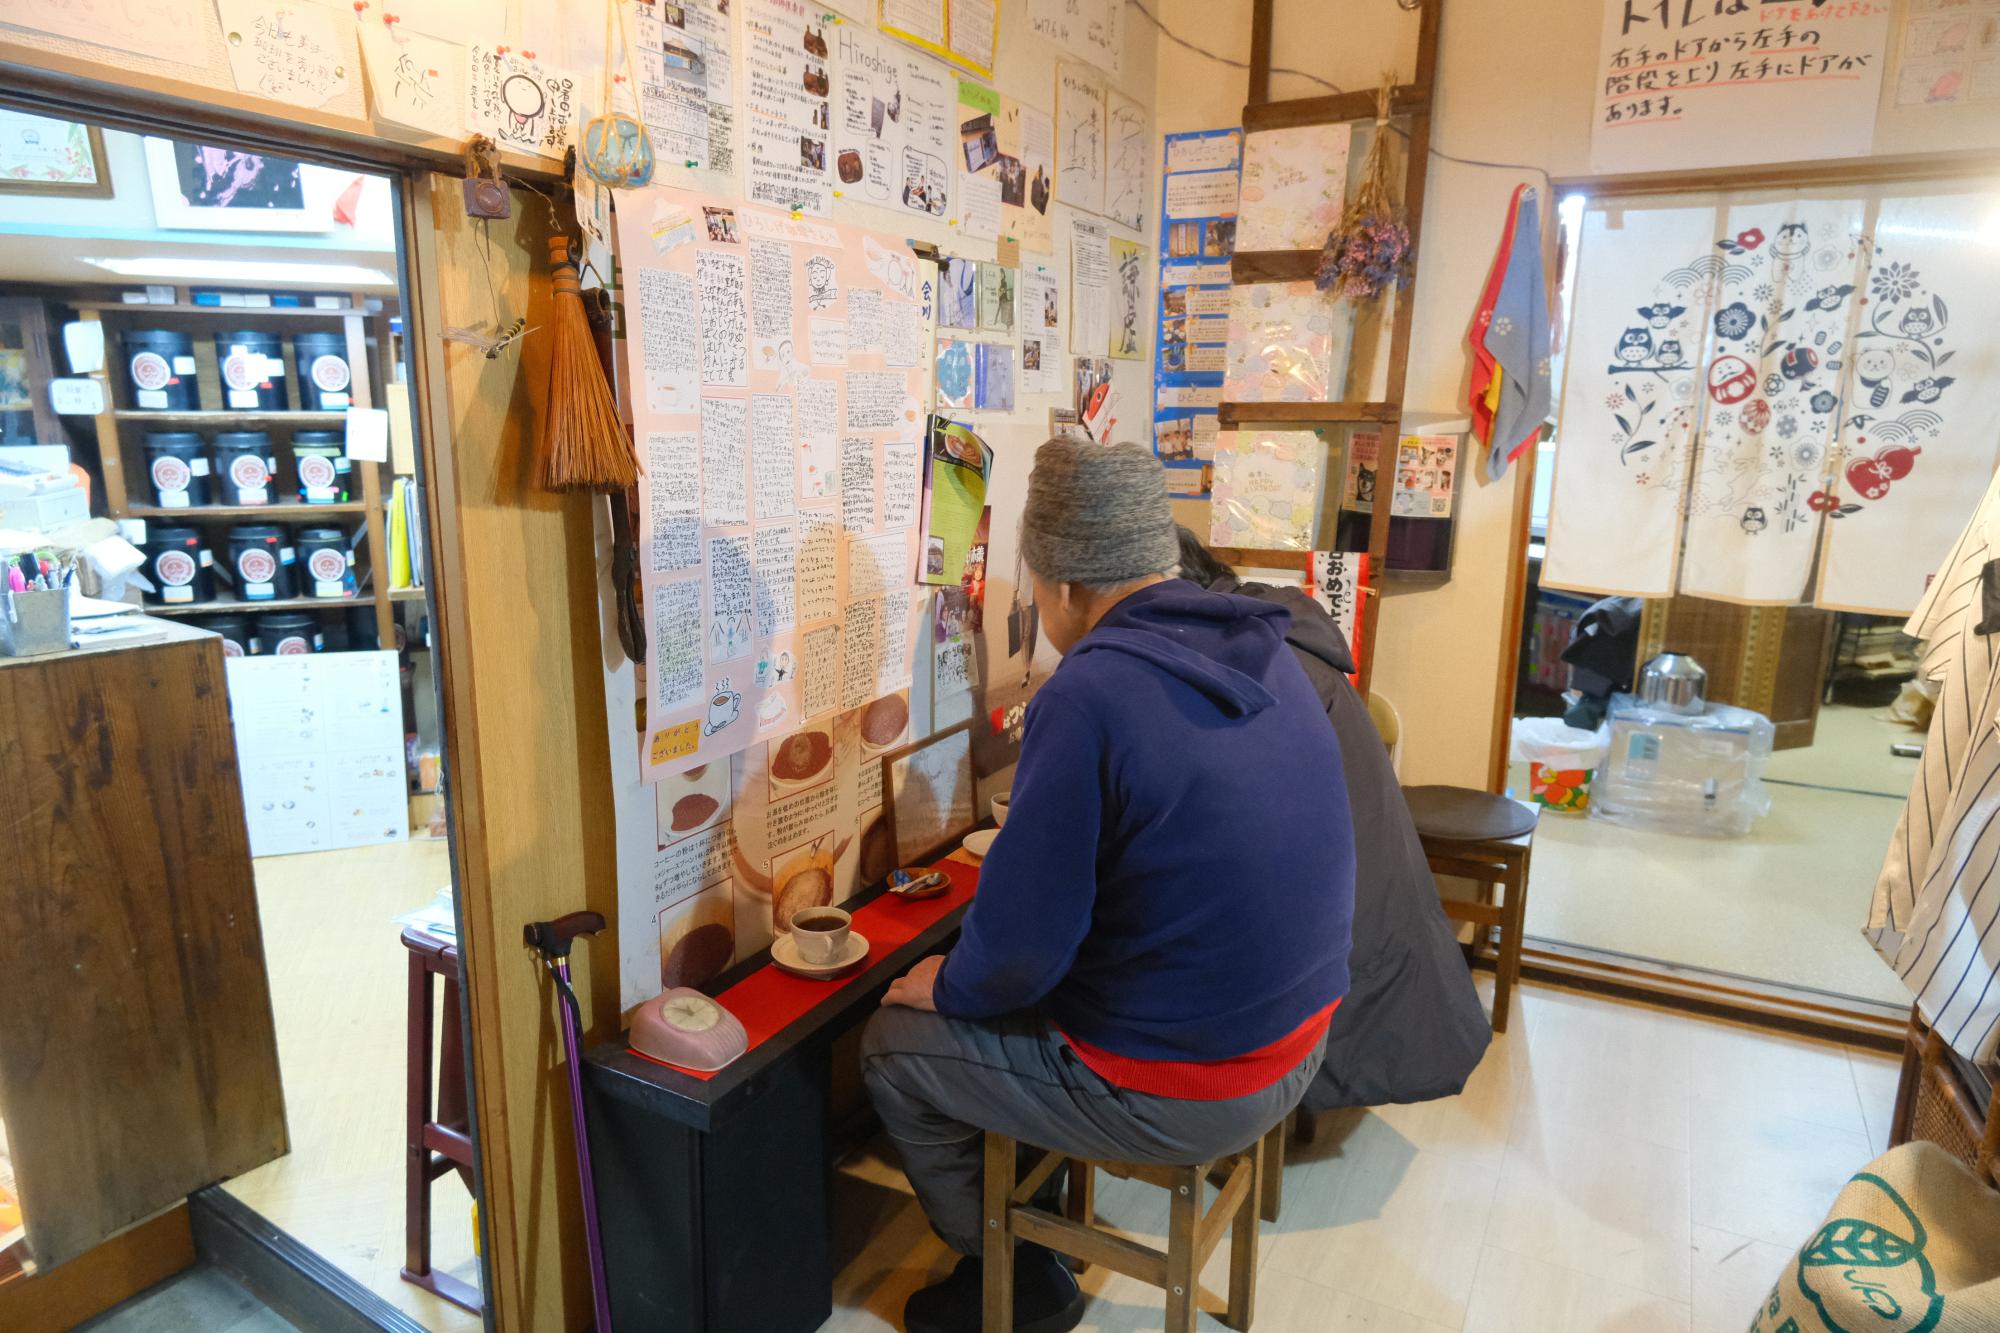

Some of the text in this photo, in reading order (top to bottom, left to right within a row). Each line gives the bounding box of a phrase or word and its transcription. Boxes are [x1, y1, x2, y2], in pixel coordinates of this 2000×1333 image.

[838, 28, 898, 85] Hiroshige
[1611, 25, 1820, 69] 右手のドアから左手の
[1605, 96, 1683, 123] あります。
[762, 860, 769, 870] 5
[651, 914, 657, 924] 4
